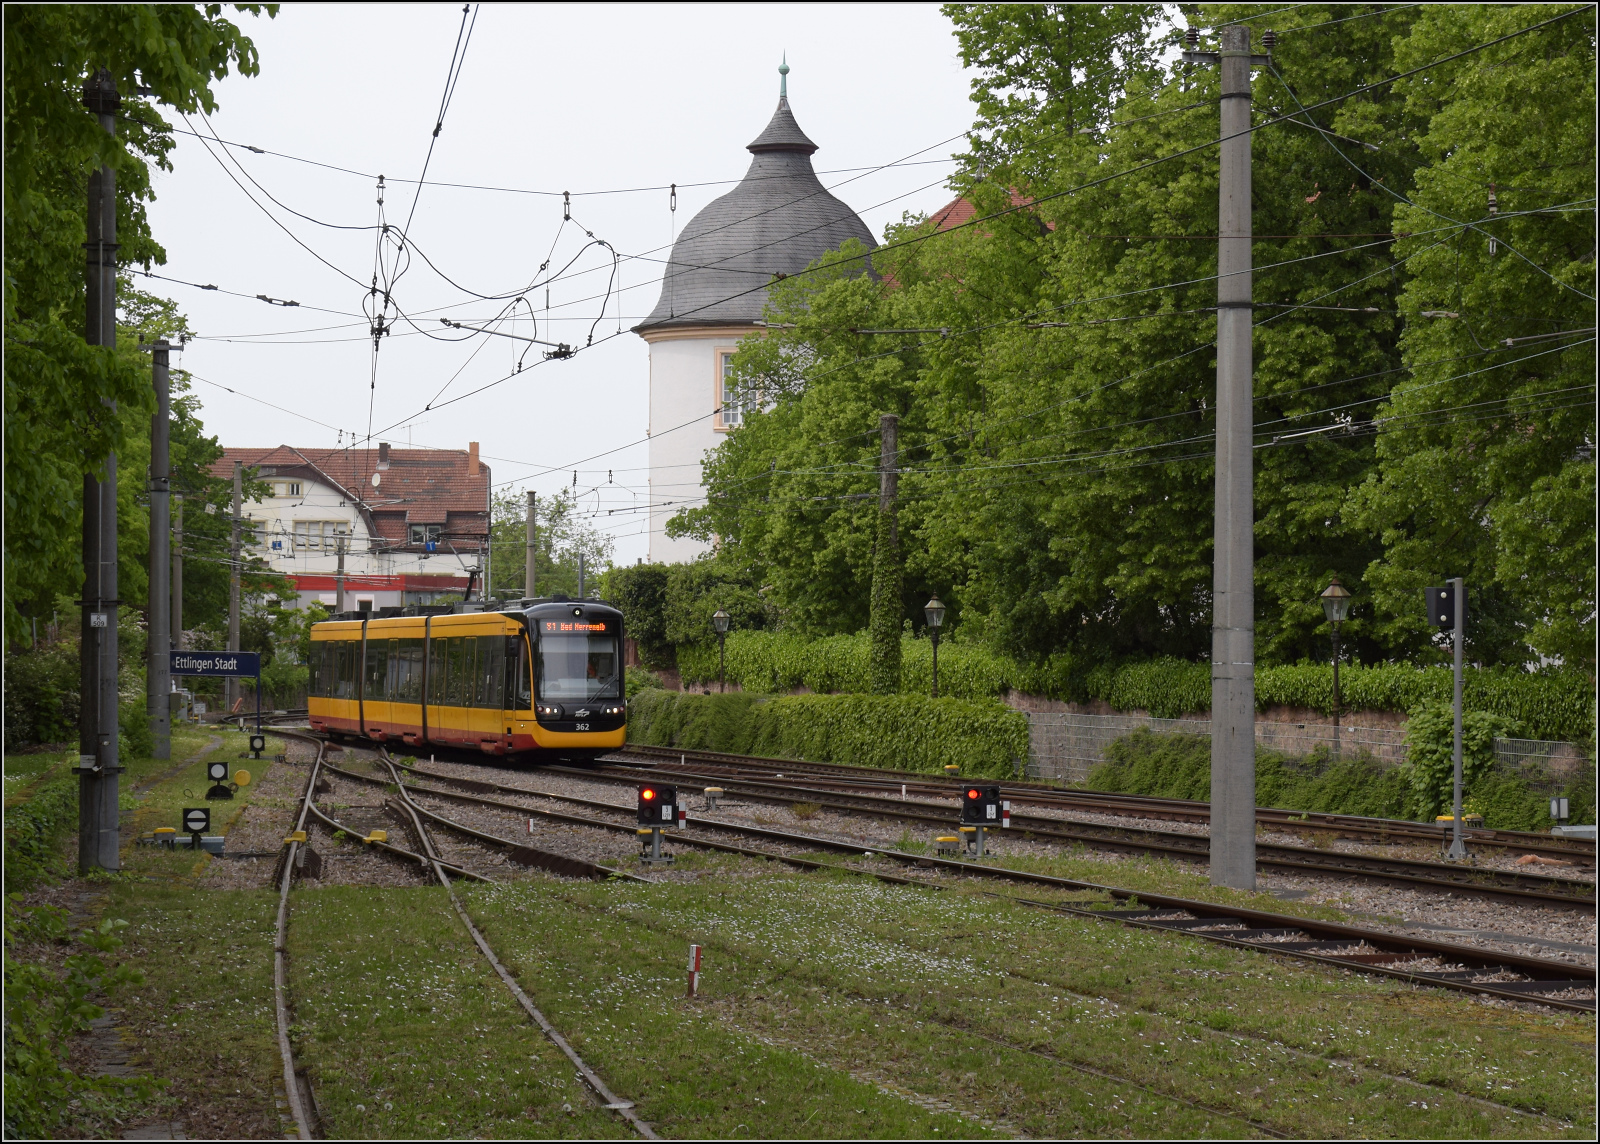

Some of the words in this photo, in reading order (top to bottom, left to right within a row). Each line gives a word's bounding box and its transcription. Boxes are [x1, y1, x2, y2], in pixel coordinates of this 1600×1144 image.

[546, 622, 556, 631] S1
[560, 622, 573, 631] Bad
[574, 622, 606, 631] Herrenalb
[175, 656, 213, 672] Ettlingen
[214, 657, 238, 670] Stadt
[575, 723, 590, 731] 362
